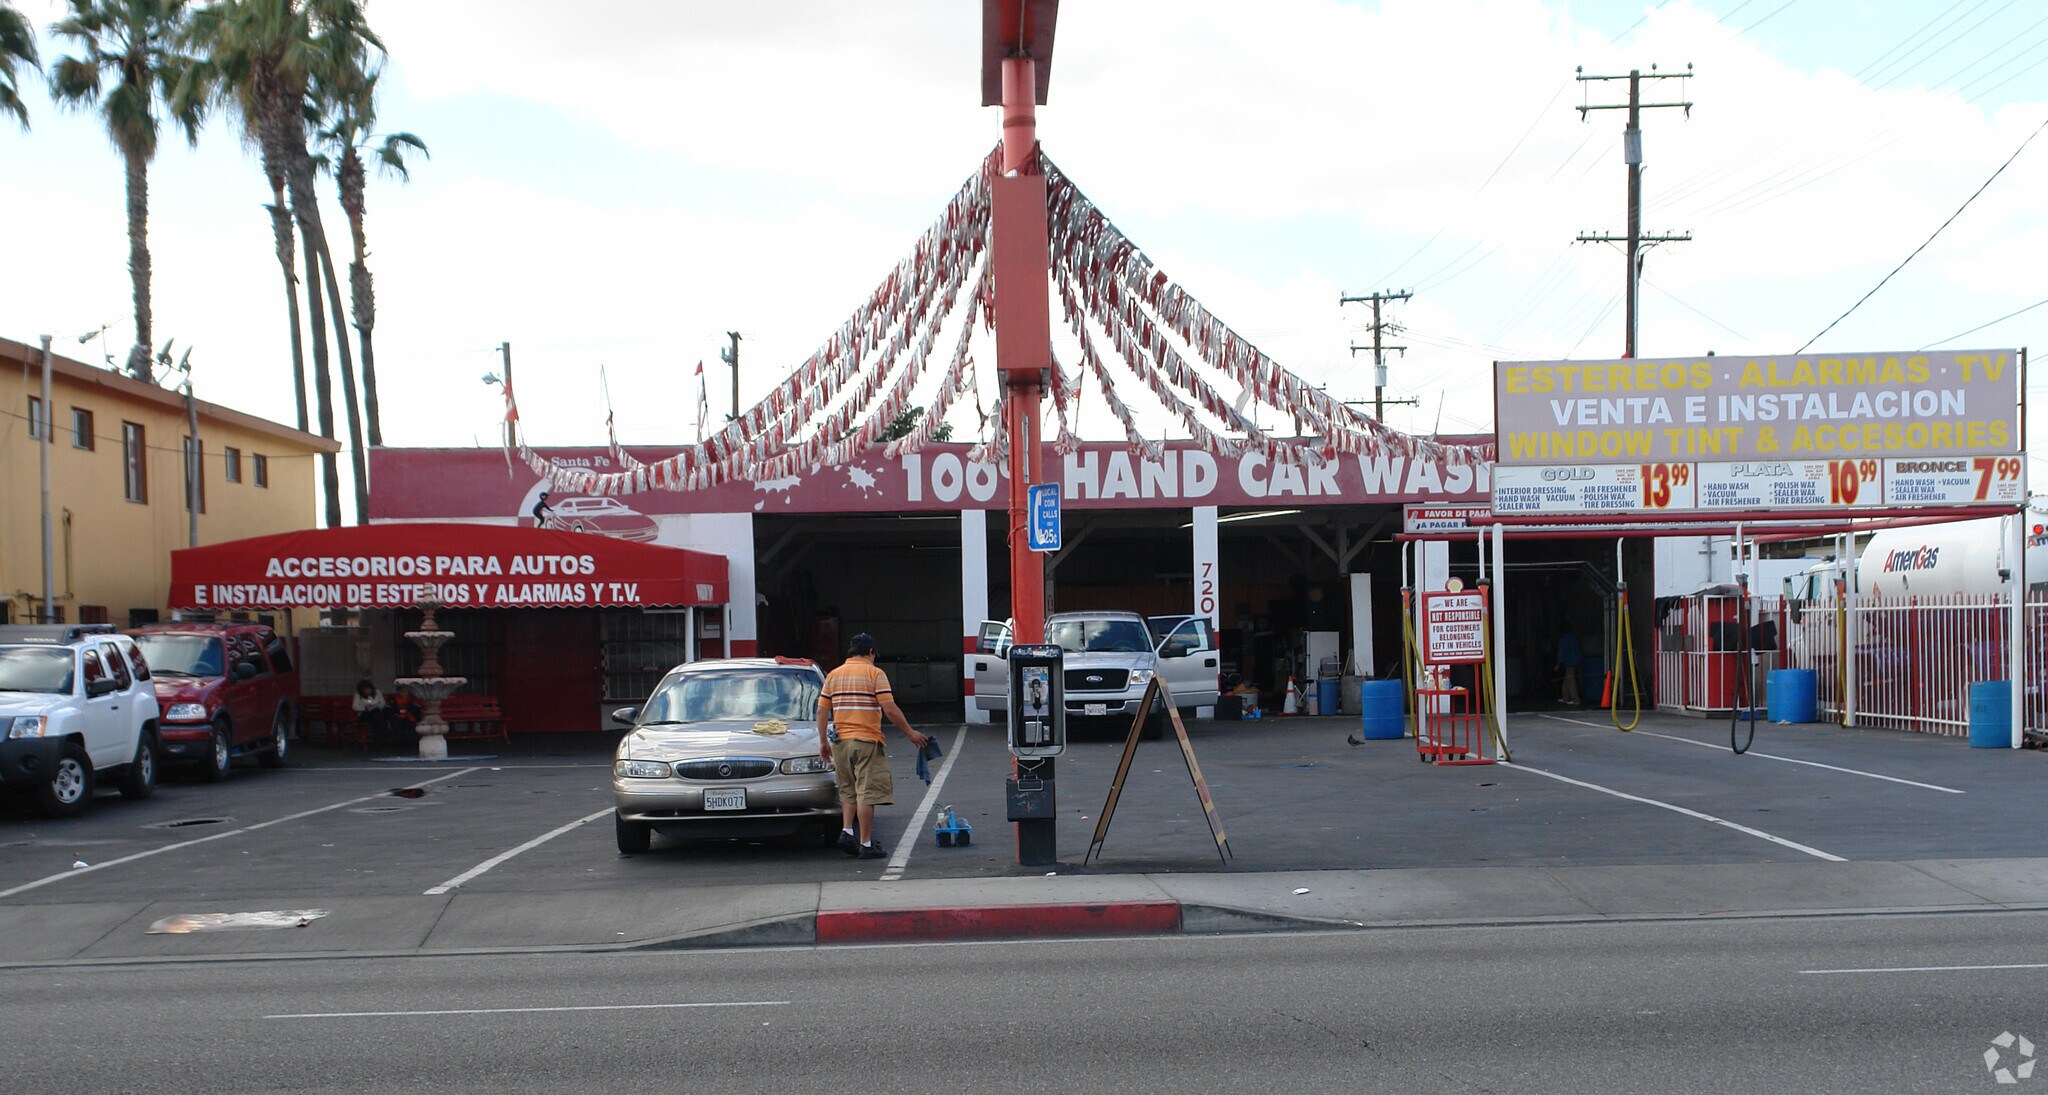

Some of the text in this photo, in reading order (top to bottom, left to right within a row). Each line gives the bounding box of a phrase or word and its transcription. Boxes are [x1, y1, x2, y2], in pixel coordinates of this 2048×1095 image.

[1506, 355, 2007, 393] ESTEREOS ALARMAS TV
[1550, 389, 1965, 426] VENTA E INSTALACION
[1508, 420, 2009, 459] WINDOW TINT & ACCESORIES
[551, 455, 610, 467] Santa Fe
[1730, 462, 1794, 478] PLATA
[1895, 461, 1967, 474] BRONCE
[902, 452, 1010, 502] 100
[1063, 450, 1218, 499] HAND
[1238, 451, 1342, 498] CAR
[1540, 467, 1596, 481] GOLD
[1728, 482, 1749, 490] WASH
[1800, 481, 1816, 489] WAX
[1915, 478, 1935, 486] WASH
[1942, 478, 1970, 486] VACUUM
[1498, 486, 1567, 495] INTERIOR DRESSING
[1597, 485, 1637, 493] FRESHENER
[1774, 489, 1799, 497] SEALER
[1519, 494, 1540, 502] WASH
[1546, 494, 1575, 502] VACUUM
[1584, 493, 1626, 501] POLISH WAX
[1707, 490, 1737, 498] VACUUM
[1584, 500, 1635, 509] TIRE DRESSING
[1707, 497, 1761, 506] AIR FRESHENER
[1790, 496, 1825, 504] DRESSING
[1524, 502, 1541, 510] WAX
[1042, 510, 1058, 519] CALLS
[1424, 510, 1453, 518] FAVOR
[1429, 521, 1459, 529] PAGAR
[1883, 544, 1939, 573] AmeriGas
[265, 554, 595, 578] ACCESORIOS PARA AUTOS
[194, 584, 208, 605] E
[212, 584, 342, 604] INSTALACION
[347, 584, 372, 604] DE
[474, 583, 489, 603] Y
[494, 583, 586, 603] ALARMAS
[590, 582, 604, 602] Y
[609, 583, 641, 603] T.V.
[1444, 598, 1468, 608] WE ARE
[1431, 610, 1481, 622] NOT RESPONSIBLE
[1433, 624, 1480, 633] FOR CUSTOMERS
[1439, 633, 1475, 641] BELONGINGS
[1432, 642, 1445, 650] LEFT
[1456, 641, 1482, 649] VEHICLES
